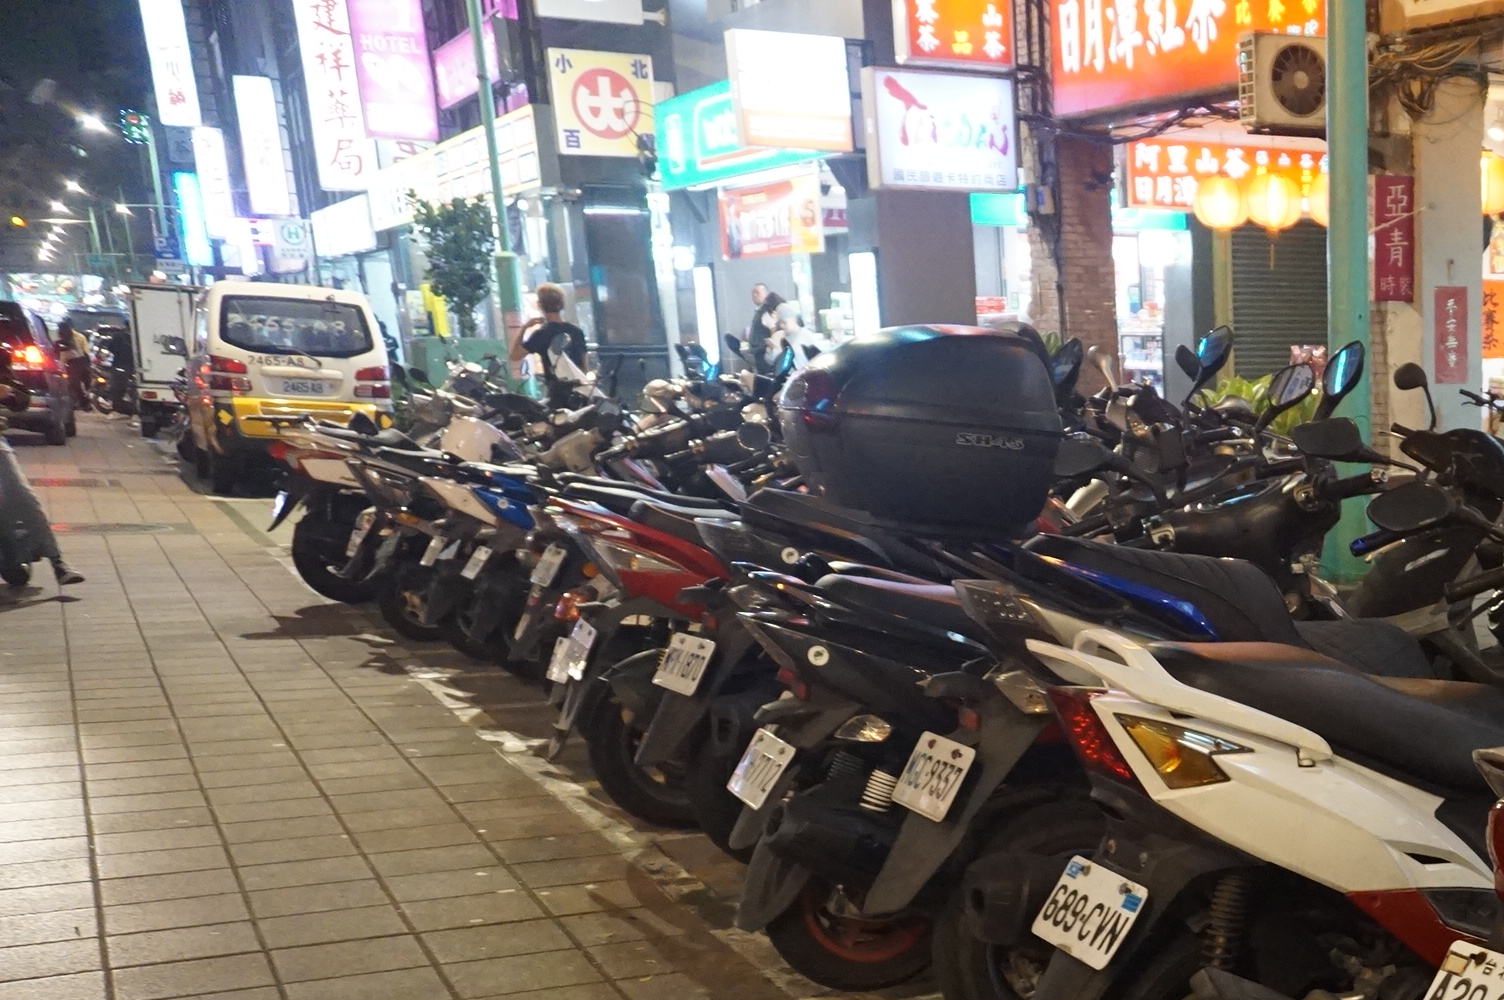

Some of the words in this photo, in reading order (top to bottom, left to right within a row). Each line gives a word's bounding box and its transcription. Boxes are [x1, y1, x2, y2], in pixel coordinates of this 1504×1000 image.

[360, 33, 422, 54] HOTEL
[1135, 143, 1250, 179] 阿里山茶
